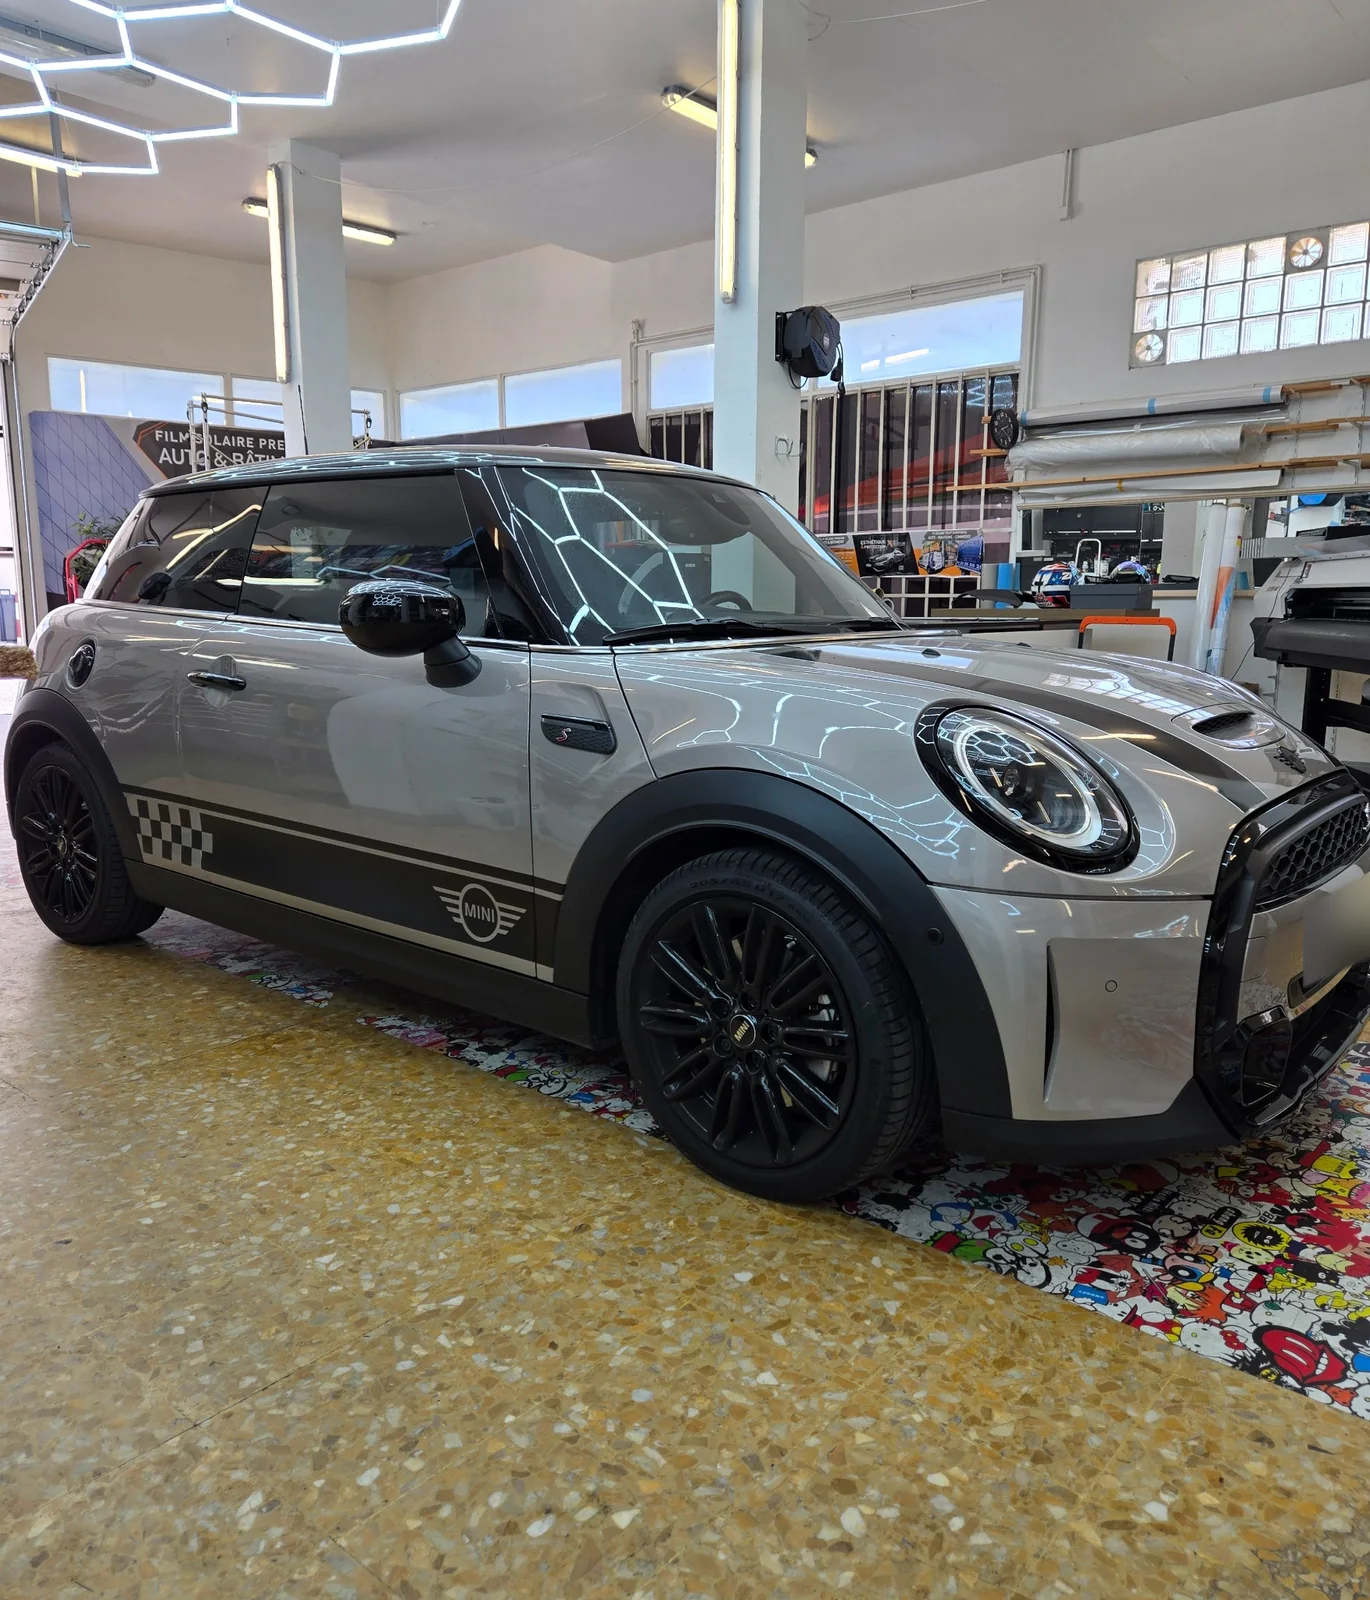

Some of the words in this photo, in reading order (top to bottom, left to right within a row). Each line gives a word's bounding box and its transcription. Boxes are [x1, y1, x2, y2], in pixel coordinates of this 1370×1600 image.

[155, 430, 190, 444] FILM
[159, 448, 210, 467] AUTO
[232, 449, 285, 466] BÂT
[464, 902, 496, 924] MINI
[734, 1020, 750, 1042] MINI
